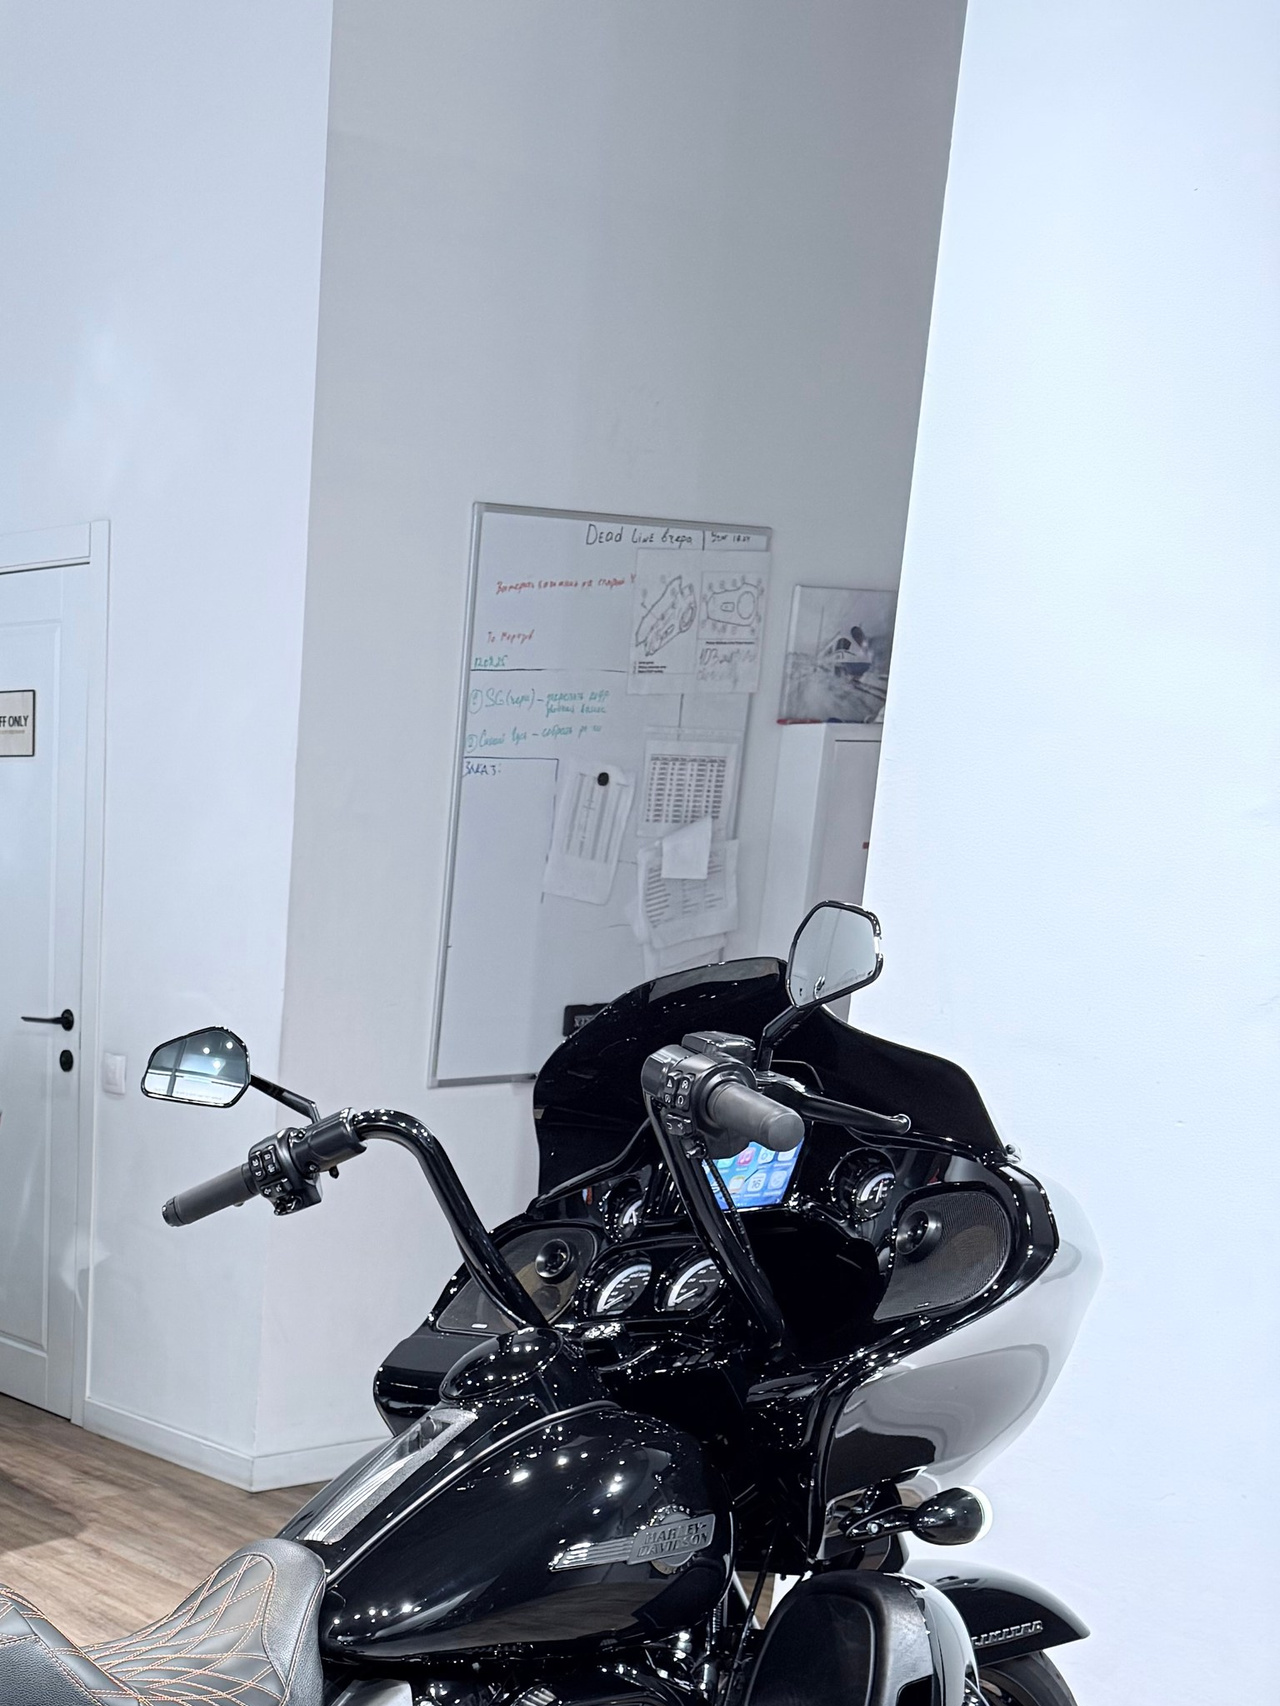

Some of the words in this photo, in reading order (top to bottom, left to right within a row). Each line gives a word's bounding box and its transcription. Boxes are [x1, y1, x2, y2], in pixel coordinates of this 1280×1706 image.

[8, 714, 29, 727] ONLY
[645, 1522, 707, 1544] HARLEY-
[637, 1533, 708, 1557] DAVIDSON
